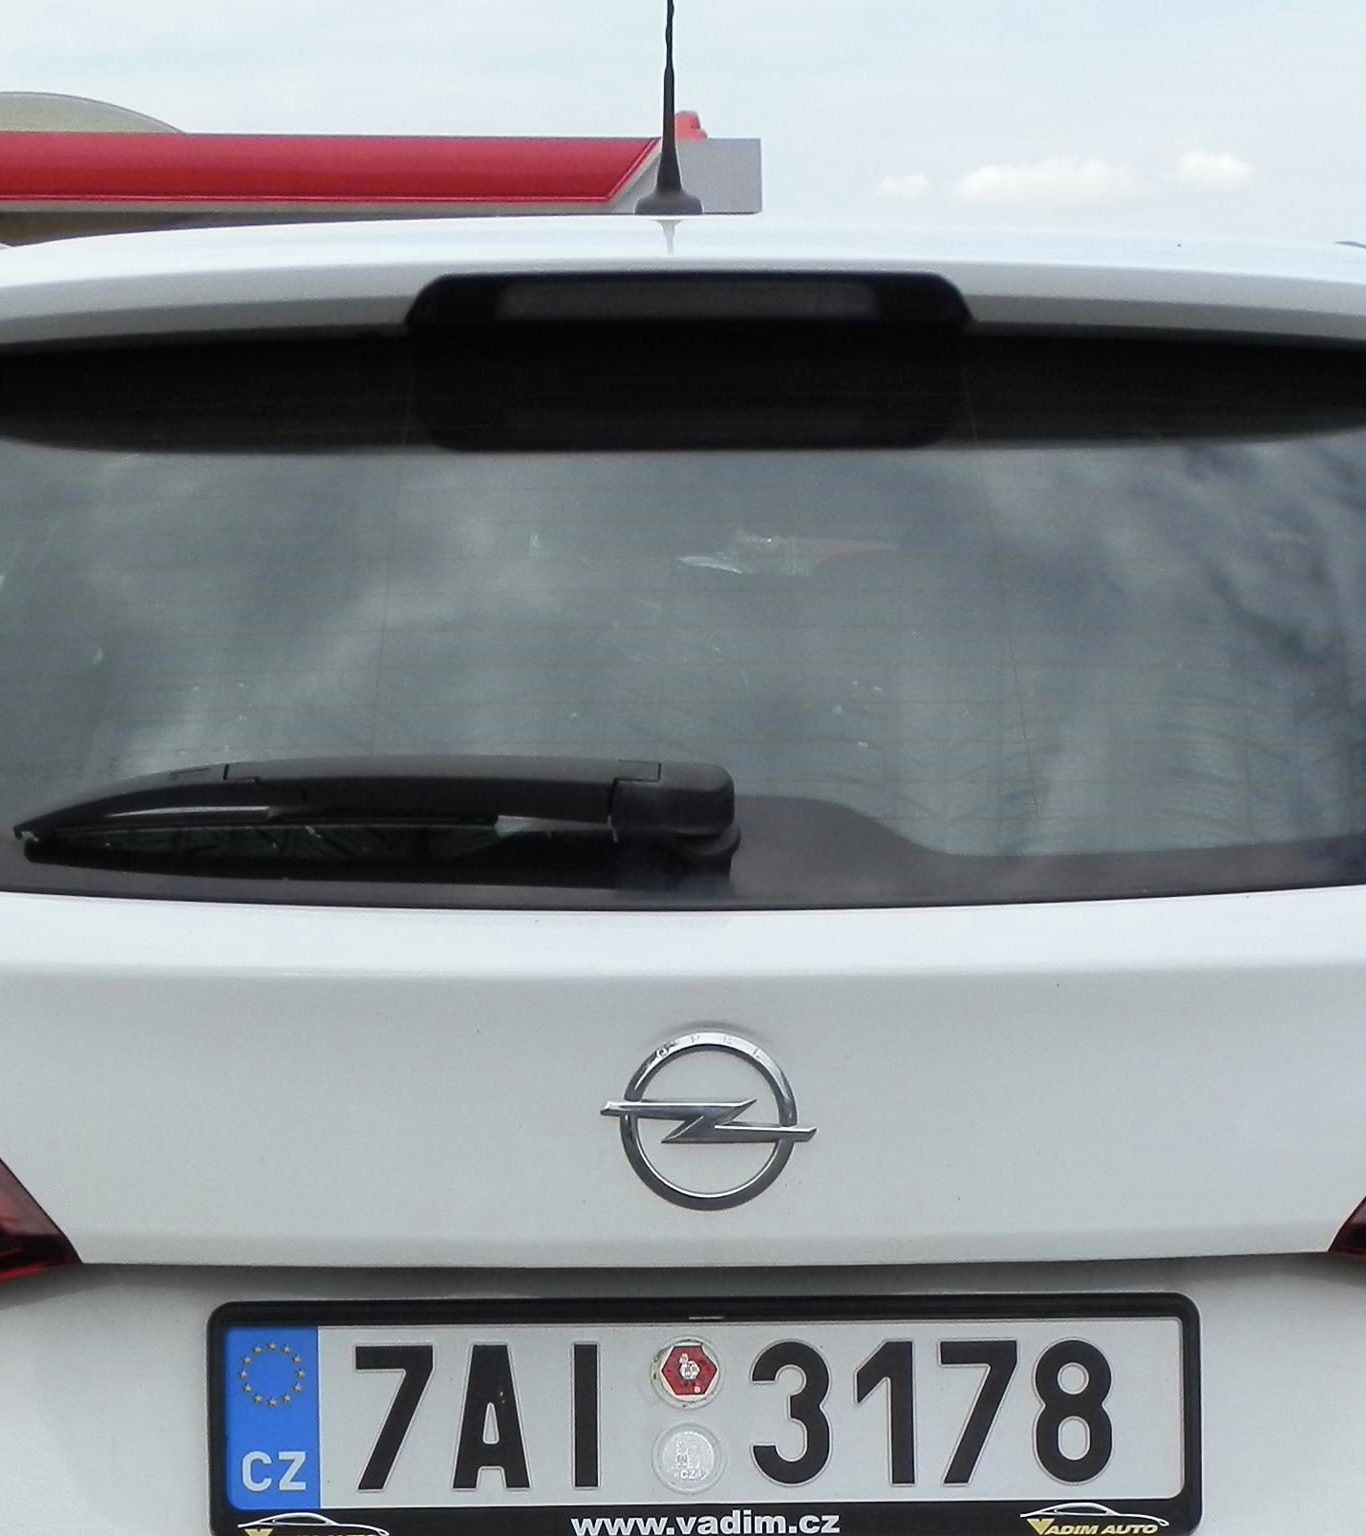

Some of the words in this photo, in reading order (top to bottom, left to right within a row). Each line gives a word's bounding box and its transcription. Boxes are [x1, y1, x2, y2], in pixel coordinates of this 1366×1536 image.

[354, 1344, 599, 1491] 7AI
[750, 1339, 1113, 1487] 3178
[242, 1451, 307, 1492] CZ
[570, 1509, 841, 1536] www.vadim.cz
[1027, 1518, 1098, 1536] VADIM
[1100, 1523, 1159, 1536] AUTO
